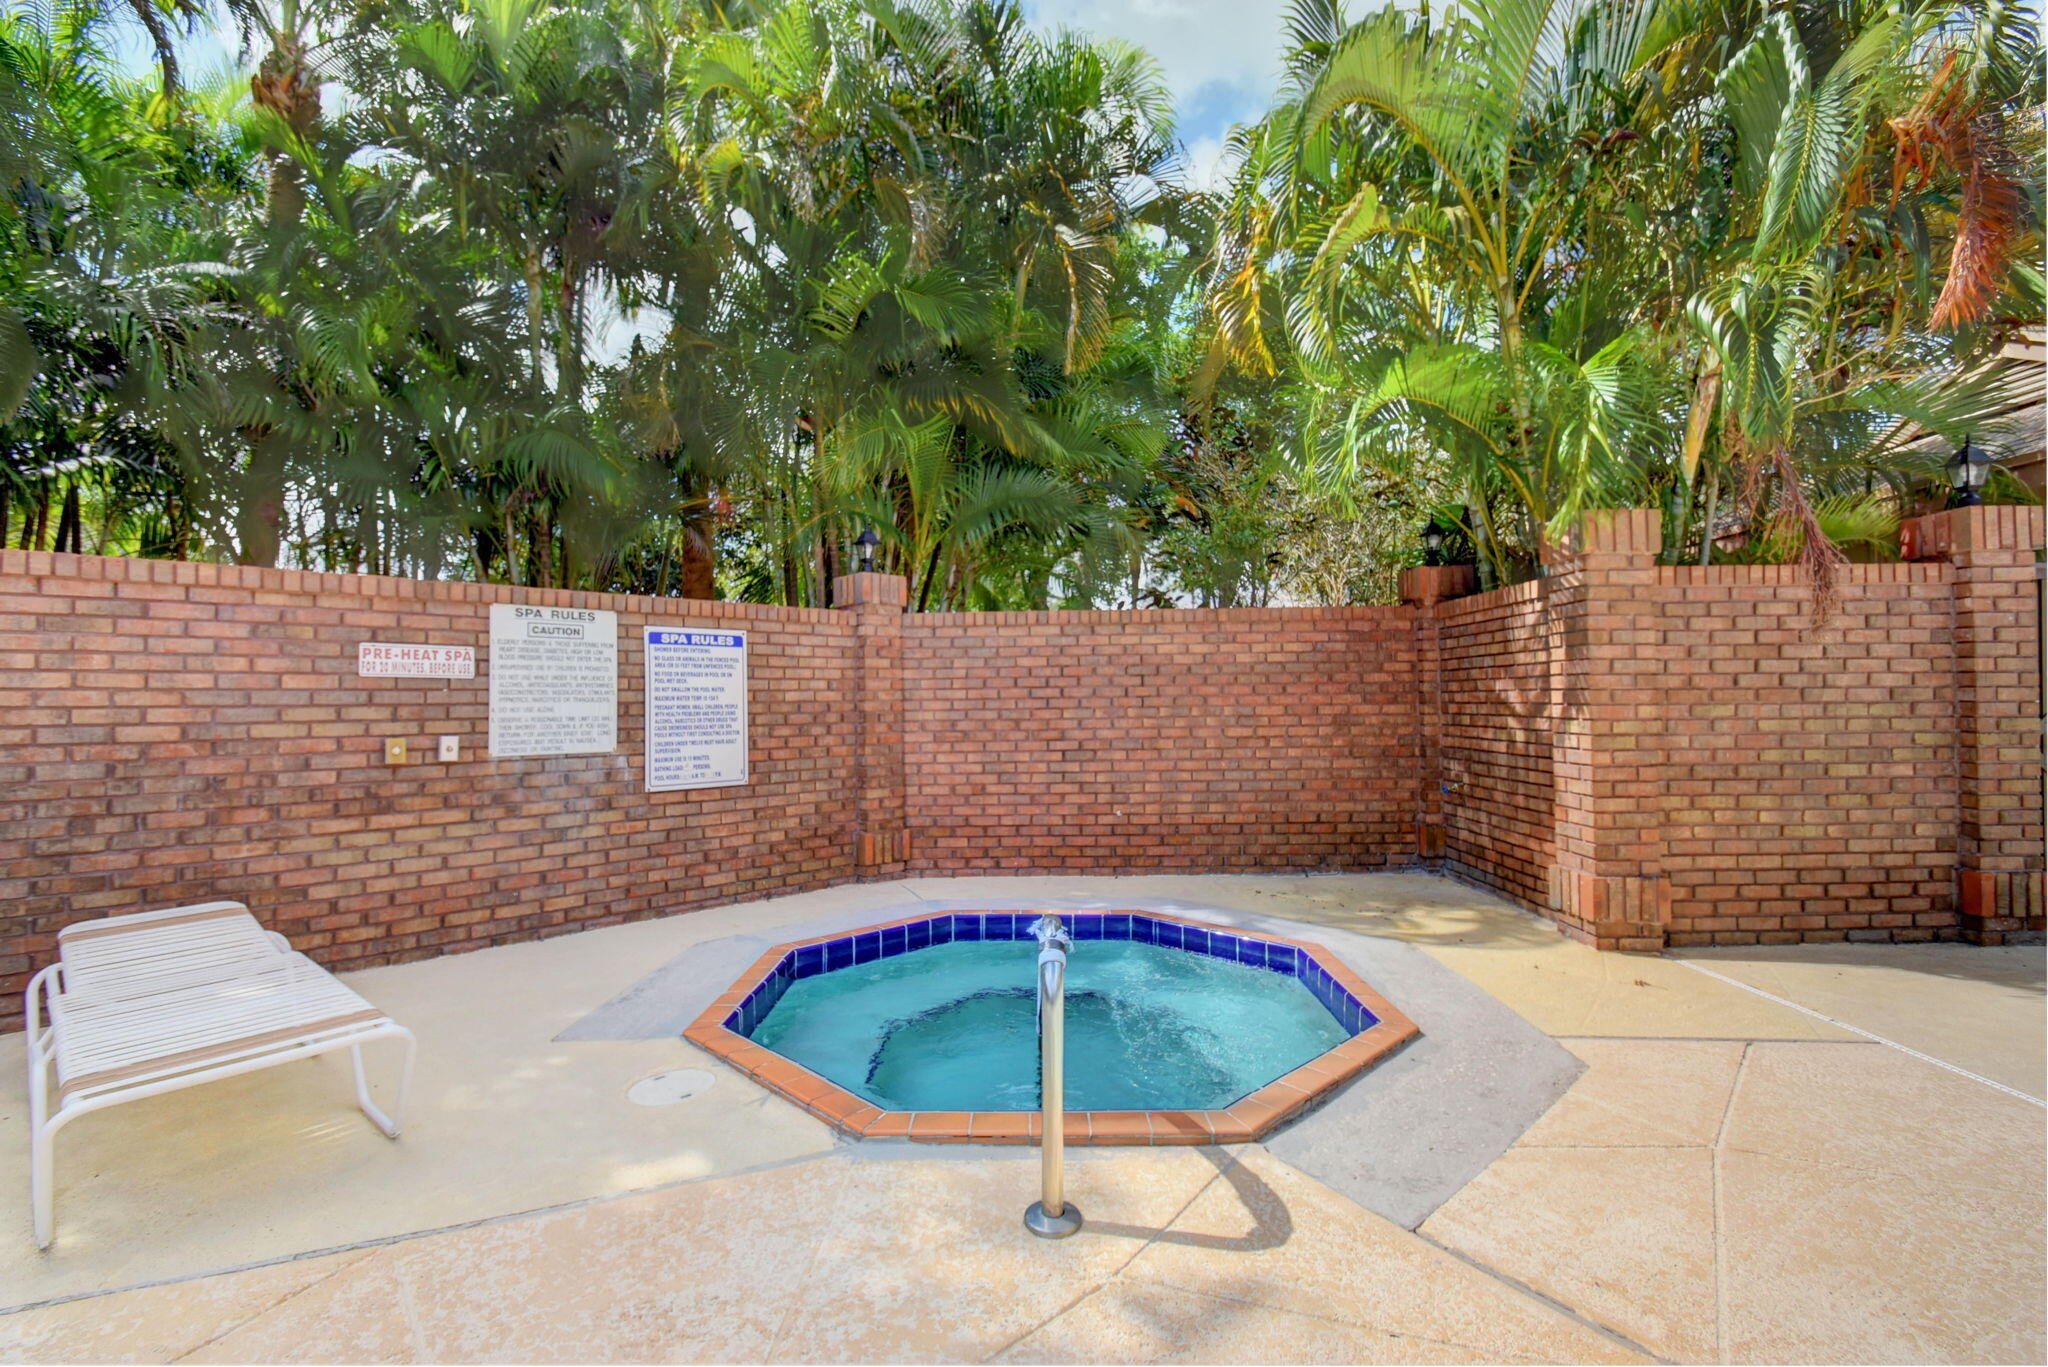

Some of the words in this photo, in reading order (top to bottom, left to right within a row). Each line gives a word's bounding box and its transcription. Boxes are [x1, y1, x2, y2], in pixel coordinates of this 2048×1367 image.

[515, 608, 543, 618] SPA
[551, 610, 596, 622] RULES
[532, 626, 581, 635] CAUTION
[661, 634, 688, 644] SPA
[691, 635, 734, 645] RULES
[362, 648, 438, 660] PRE-HEAT
[445, 651, 472, 661] SPA
[361, 661, 376, 672] FOR
[392, 662, 424, 673] MINUTES
[429, 663, 456, 674] BEFORE
